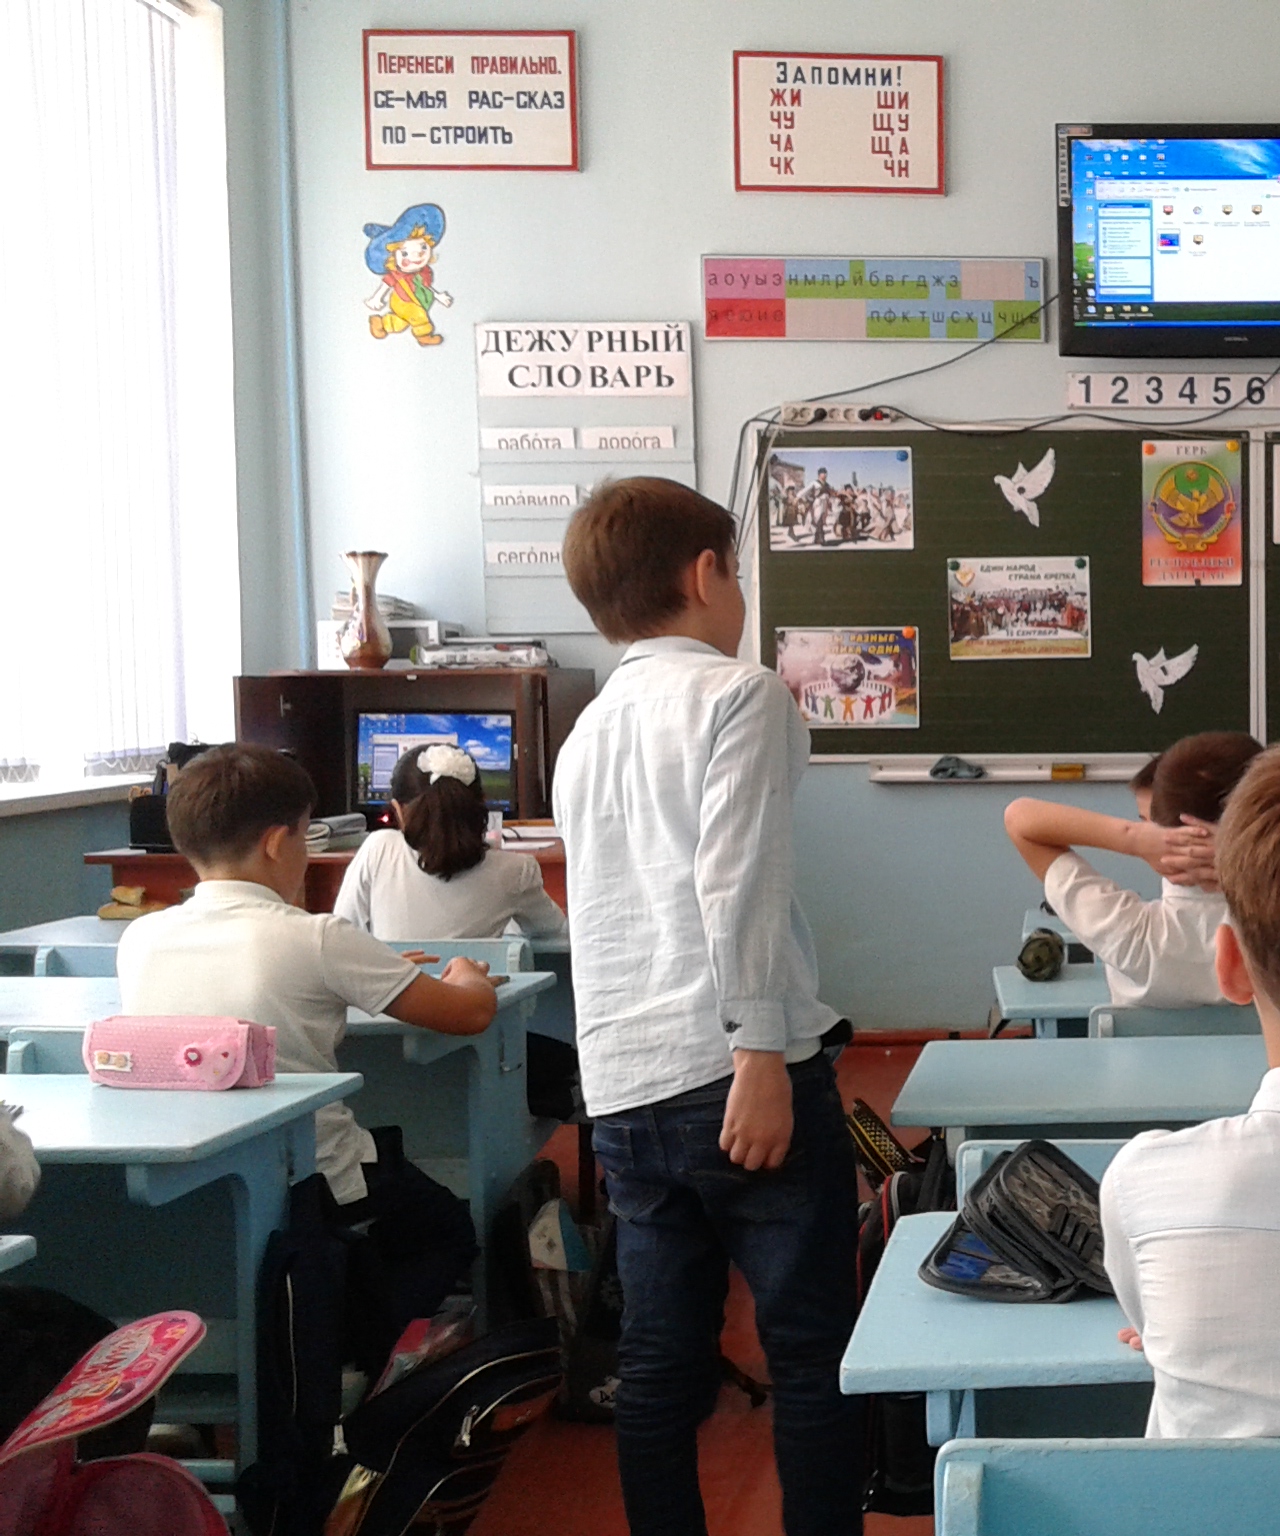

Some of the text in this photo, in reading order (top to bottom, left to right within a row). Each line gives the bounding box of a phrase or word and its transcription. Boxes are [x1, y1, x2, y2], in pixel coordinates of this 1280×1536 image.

[377, 52, 562, 75] ПЕРЕНЕСИ ПРАВИЛЬНО.
[776, 62, 902, 87] ЗАПОМНИ!
[373, 90, 565, 110] СЕ-МЬЯ РАС-СКАЗ
[770, 88, 909, 110] ЖИ ШИ
[770, 111, 909, 135] ЧУ ЩУ
[770, 134, 909, 158] ЧА ЩА
[770, 157, 909, 178] ЧК ЧН
[481, 324, 685, 356] ДЕЖУРНЫЙ
[508, 365, 674, 388] СЛОВАРЬ
[1078, 376, 1092, 403] 1
[1111, 377, 1129, 403] 2
[1145, 377, 1163, 404] 3
[1178, 377, 1197, 404] 4
[1213, 377, 1231, 404] 5
[1247, 377, 1265, 404] 6
